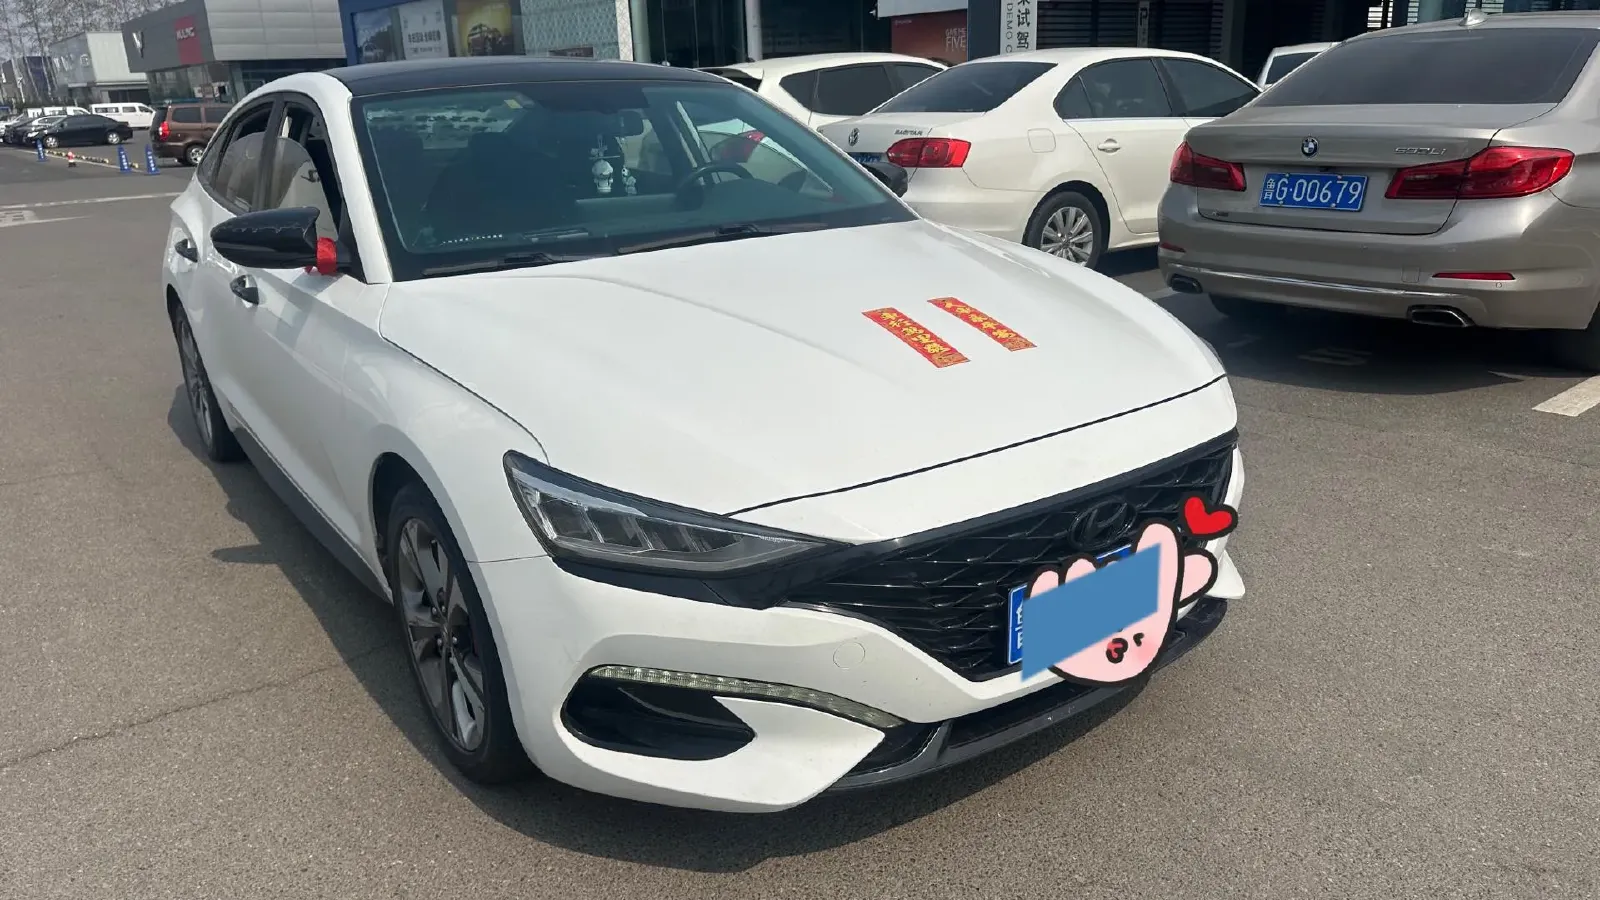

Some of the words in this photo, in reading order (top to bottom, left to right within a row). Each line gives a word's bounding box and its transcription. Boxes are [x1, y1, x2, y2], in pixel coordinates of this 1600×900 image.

[1006, 3, 1014, 40] DEMO
[1016, 0, 1031, 49] 试驾
[945, 36, 967, 48] FIVE
